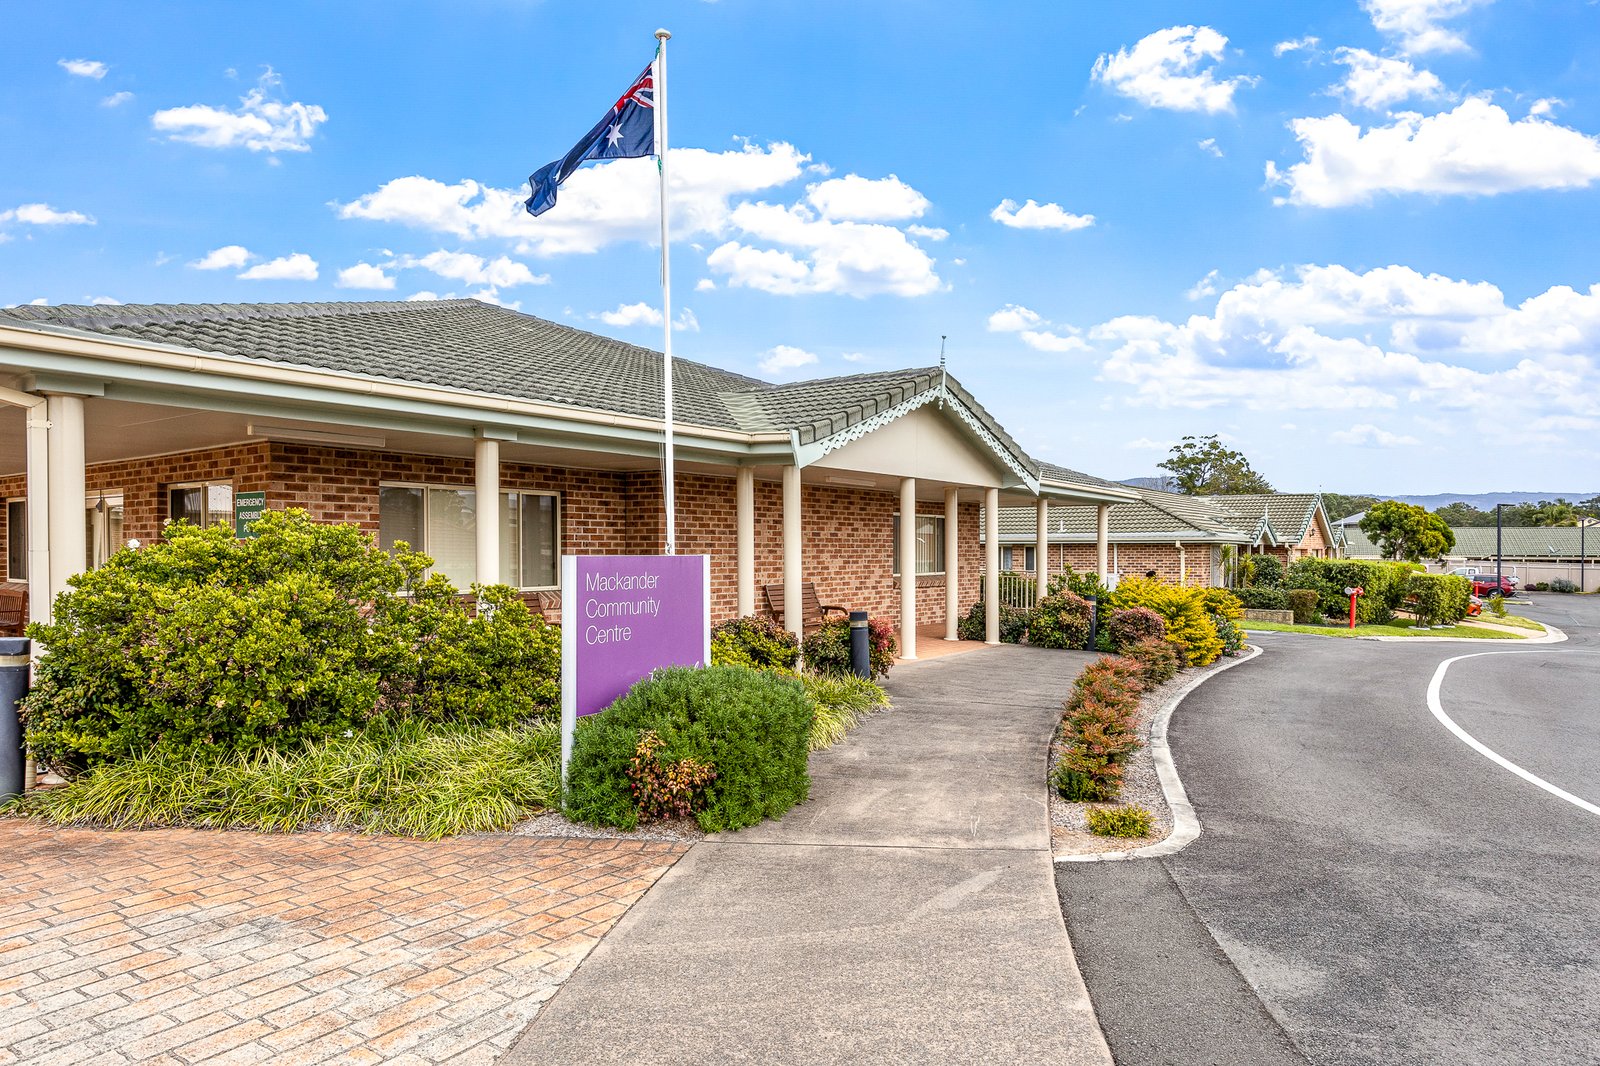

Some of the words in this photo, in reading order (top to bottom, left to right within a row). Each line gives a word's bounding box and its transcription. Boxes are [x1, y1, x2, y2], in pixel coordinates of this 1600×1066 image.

[236, 498, 264, 507] EMERGENCY
[239, 511, 261, 520] ASSEMBL
[586, 571, 660, 592] Mackander
[585, 596, 661, 618] Community
[585, 624, 632, 645] Centre
